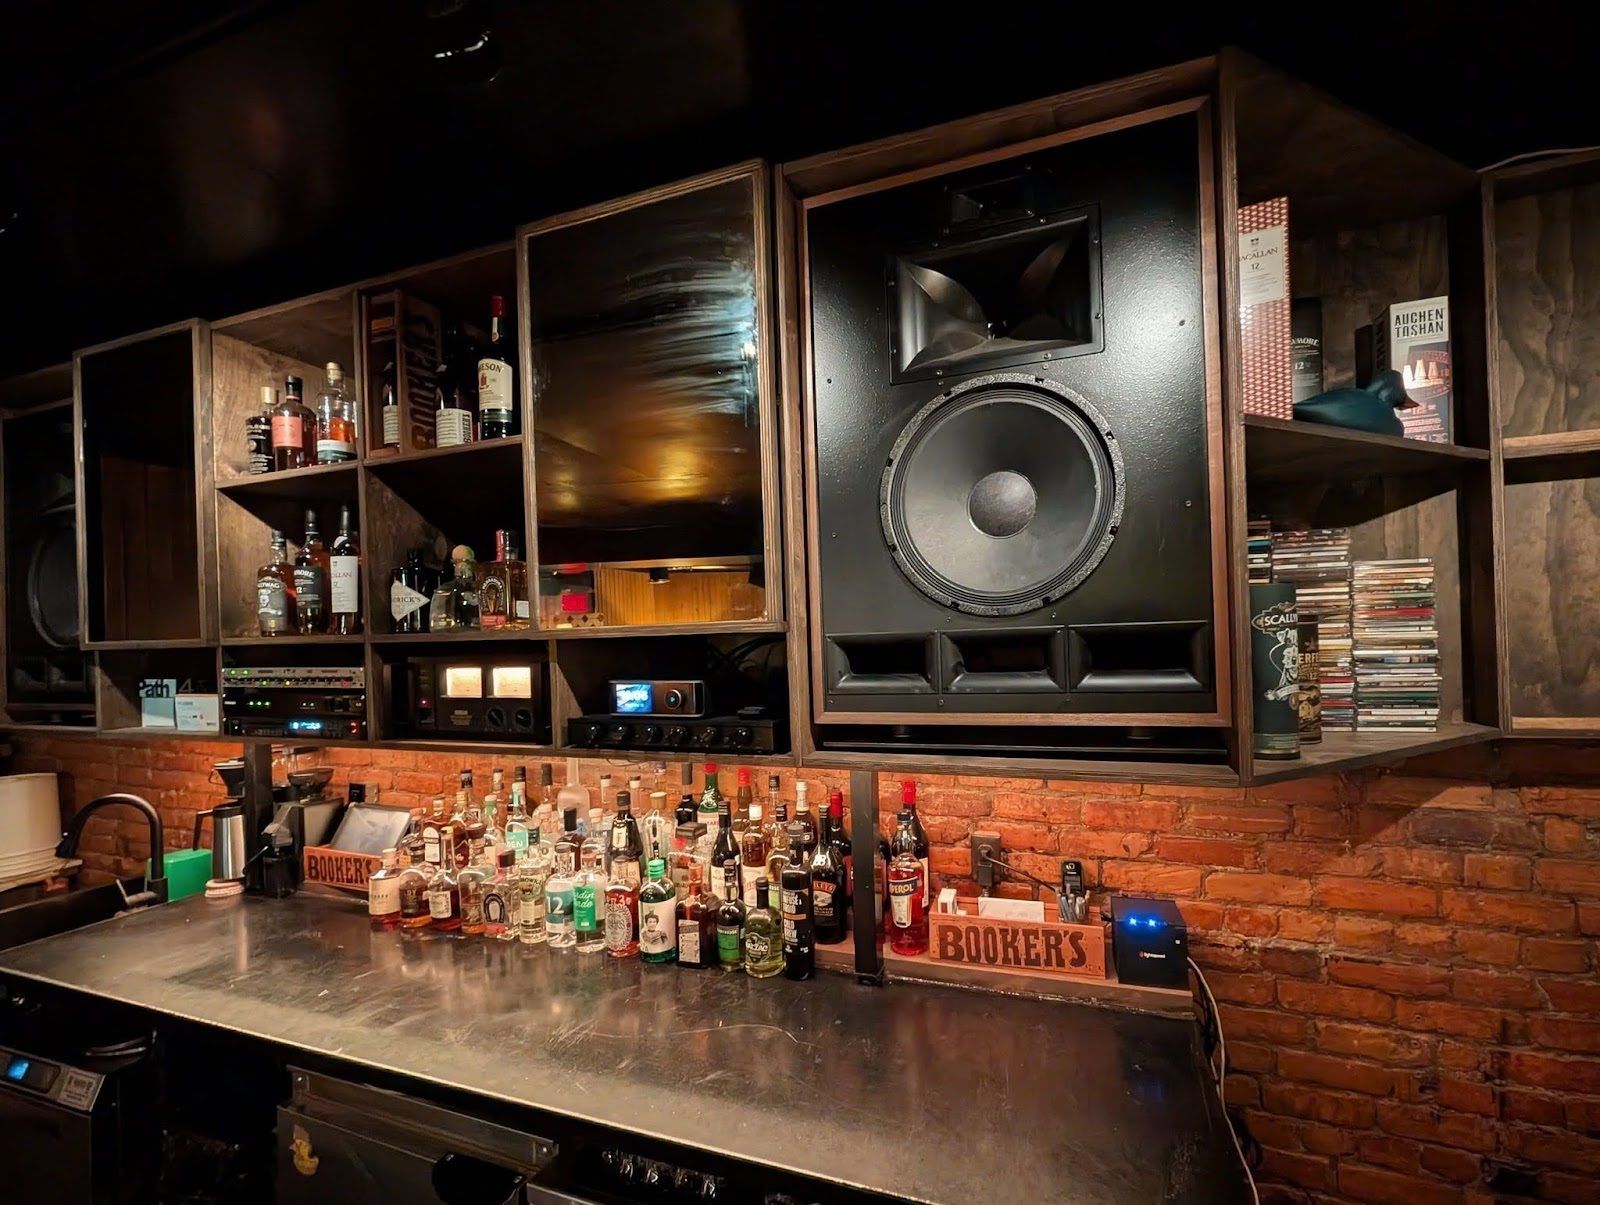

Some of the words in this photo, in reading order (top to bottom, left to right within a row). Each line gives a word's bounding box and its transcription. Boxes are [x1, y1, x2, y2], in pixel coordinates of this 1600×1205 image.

[1395, 308, 1444, 326] AUCHEN
[1395, 321, 1444, 338] TOSHAN
[307, 854, 373, 884] BOOKER'S
[939, 924, 1087, 968] BOOKER'S
